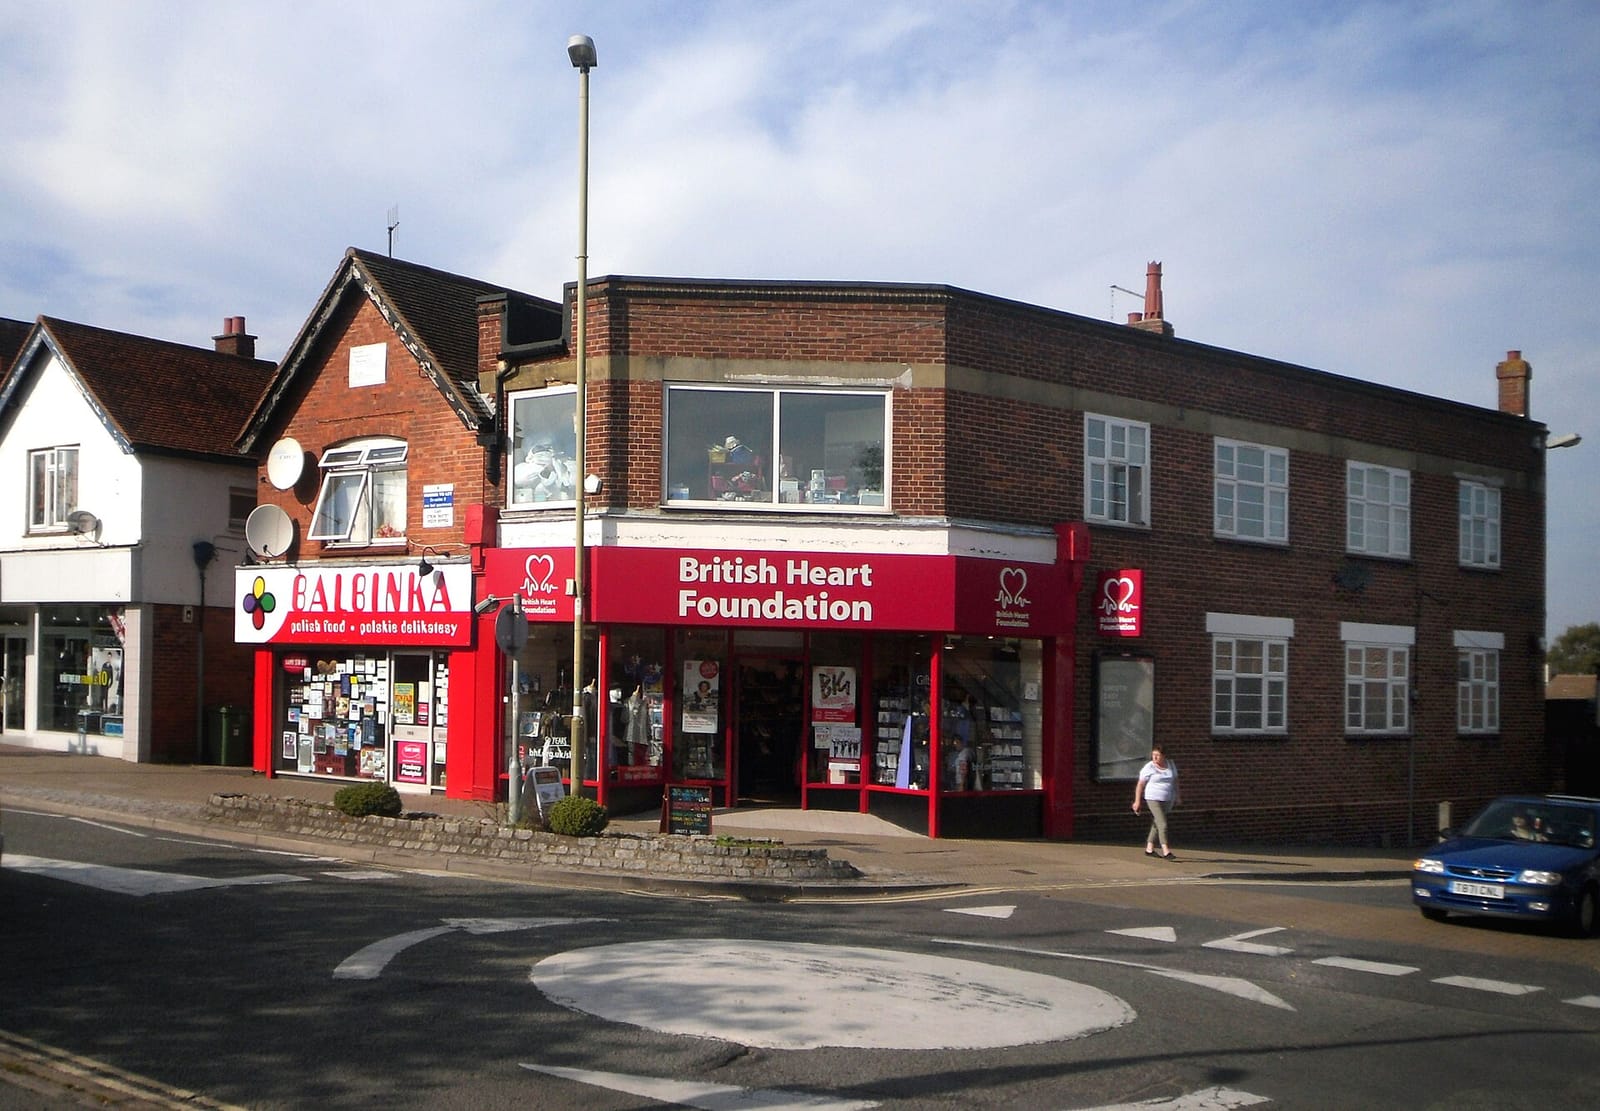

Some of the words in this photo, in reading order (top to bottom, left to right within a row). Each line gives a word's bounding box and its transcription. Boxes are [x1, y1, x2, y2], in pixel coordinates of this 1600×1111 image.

[679, 557, 777, 584] British
[787, 560, 872, 587] Heart
[292, 571, 452, 613] BALBINKA
[521, 598, 539, 606] British
[540, 598, 556, 606] Heart
[679, 590, 872, 622] Foundation
[521, 606, 556, 614] Foundation
[996, 610, 1013, 618] British
[1014, 611, 1029, 619] Heart
[996, 618, 1029, 627] Foundation
[1100, 623, 1136, 631] Foundation
[291, 619, 321, 634] polish
[323, 619, 346, 633] food
[360, 620, 398, 635] polskie
[401, 619, 458, 636] delikatesy
